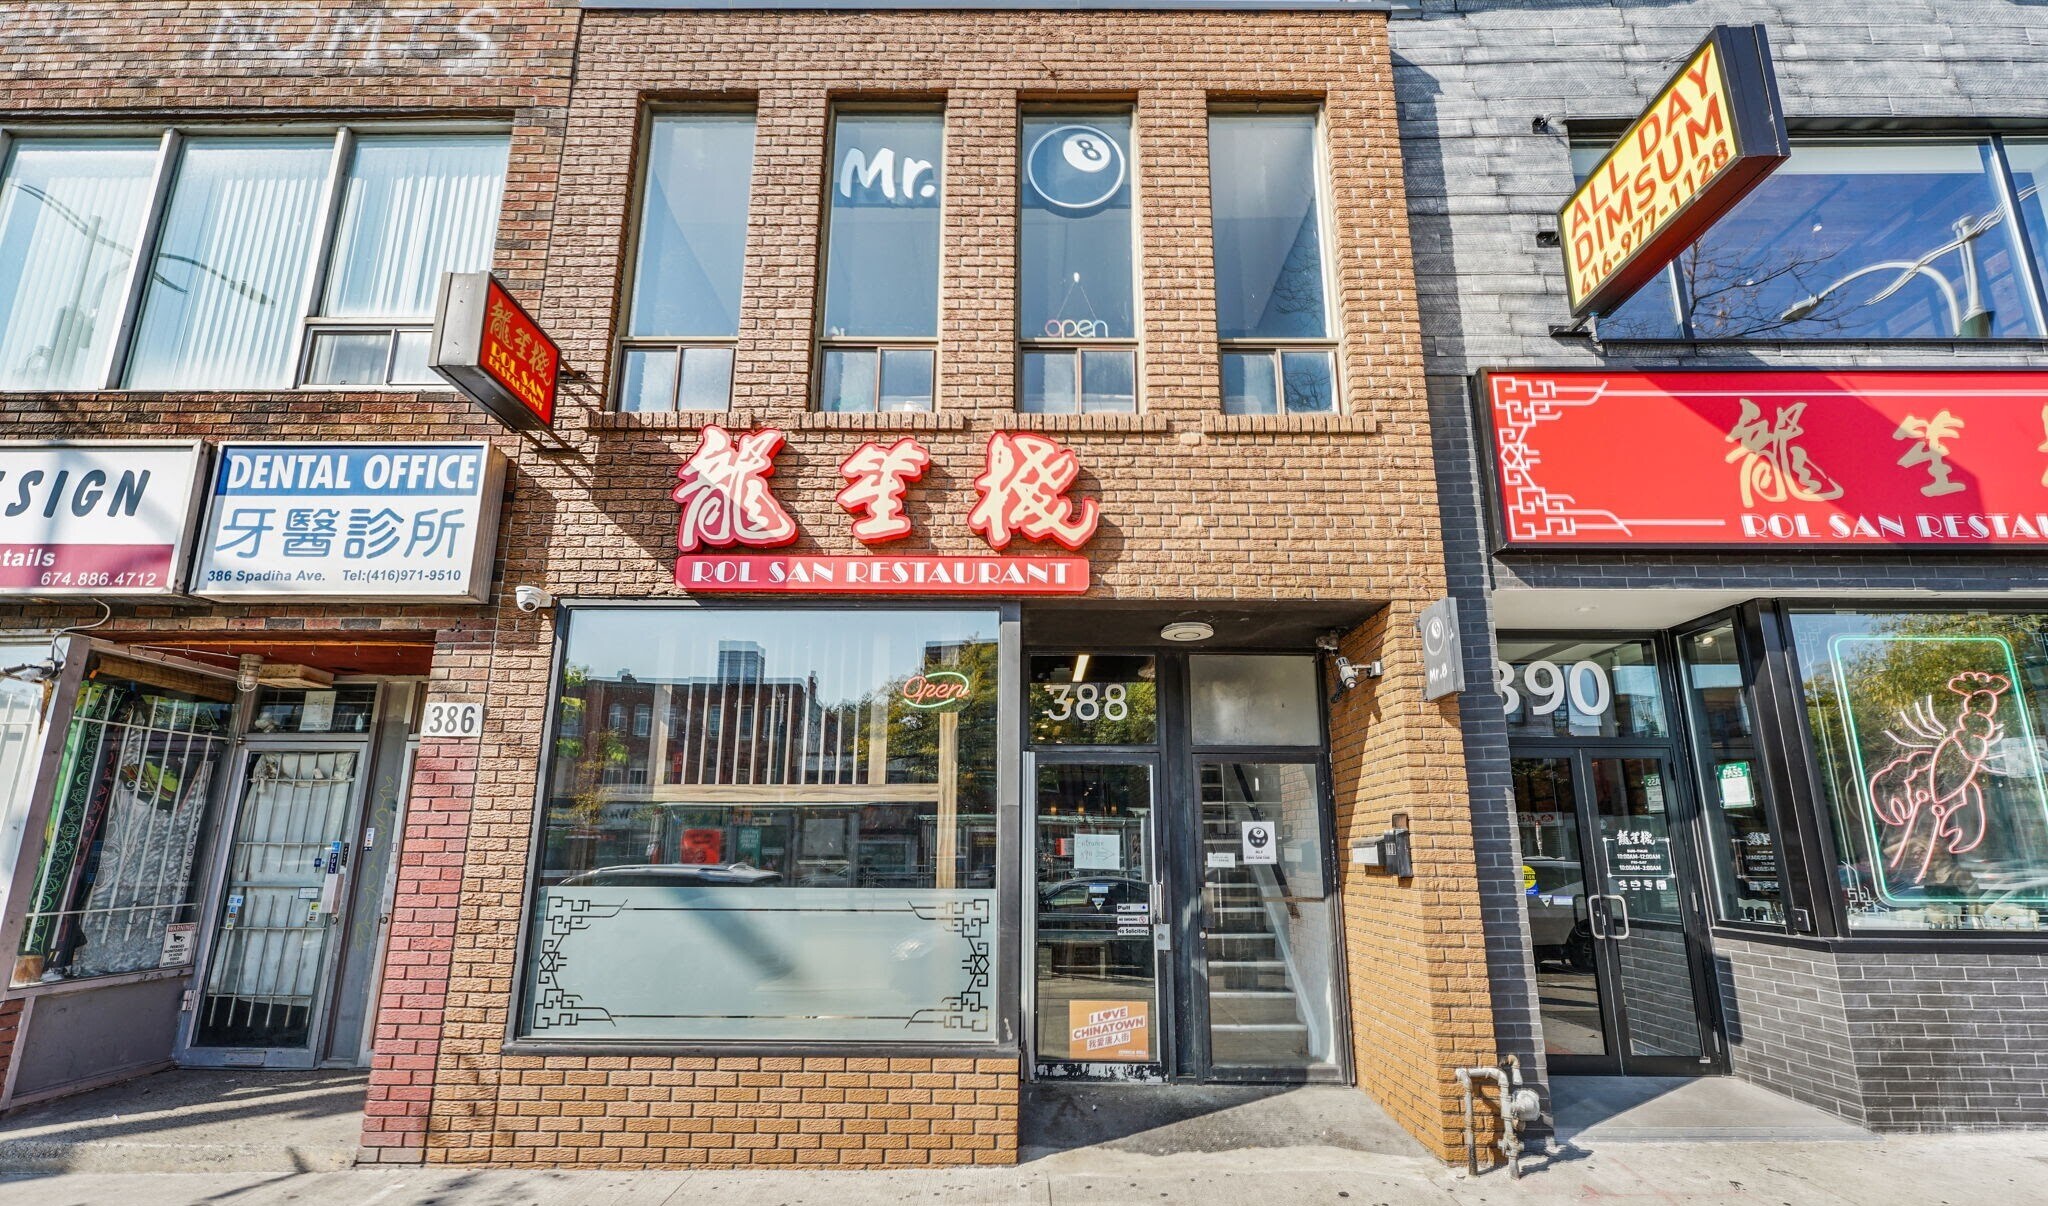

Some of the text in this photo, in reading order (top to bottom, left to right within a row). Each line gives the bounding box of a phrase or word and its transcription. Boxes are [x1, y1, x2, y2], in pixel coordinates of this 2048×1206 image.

[1571, 50, 1711, 238] ALL DAY
[840, 139, 1103, 199] Mr. 8
[1579, 139, 1730, 296] 416-977-1128
[1044, 319, 1110, 338] open
[488, 355, 544, 411] RESTAURANT
[490, 341, 546, 402] ROL SAN
[227, 454, 478, 490] DENTAL OFFICE
[0, 469, 151, 518] SIGN
[214, 507, 466, 559] 牙醫診所
[1740, 513, 1822, 538] ROL
[1828, 512, 1906, 538] SAN
[0, 548, 56, 567] tails
[41, 571, 157, 587] 674.886.4712
[208, 569, 326, 584] 386 Spadina Ave.
[342, 569, 461, 584] Tel:(416)971-9510
[690, 561, 1071, 585] ROL SAN RESTAURANT
[903, 675, 971, 704] Open
[1047, 684, 1128, 721] 388
[429, 705, 476, 734] 386
[327, 853, 338, 873] PULL
[168, 924, 195, 932] WARNING
[1073, 1017, 1144, 1039] CHINATOWN
